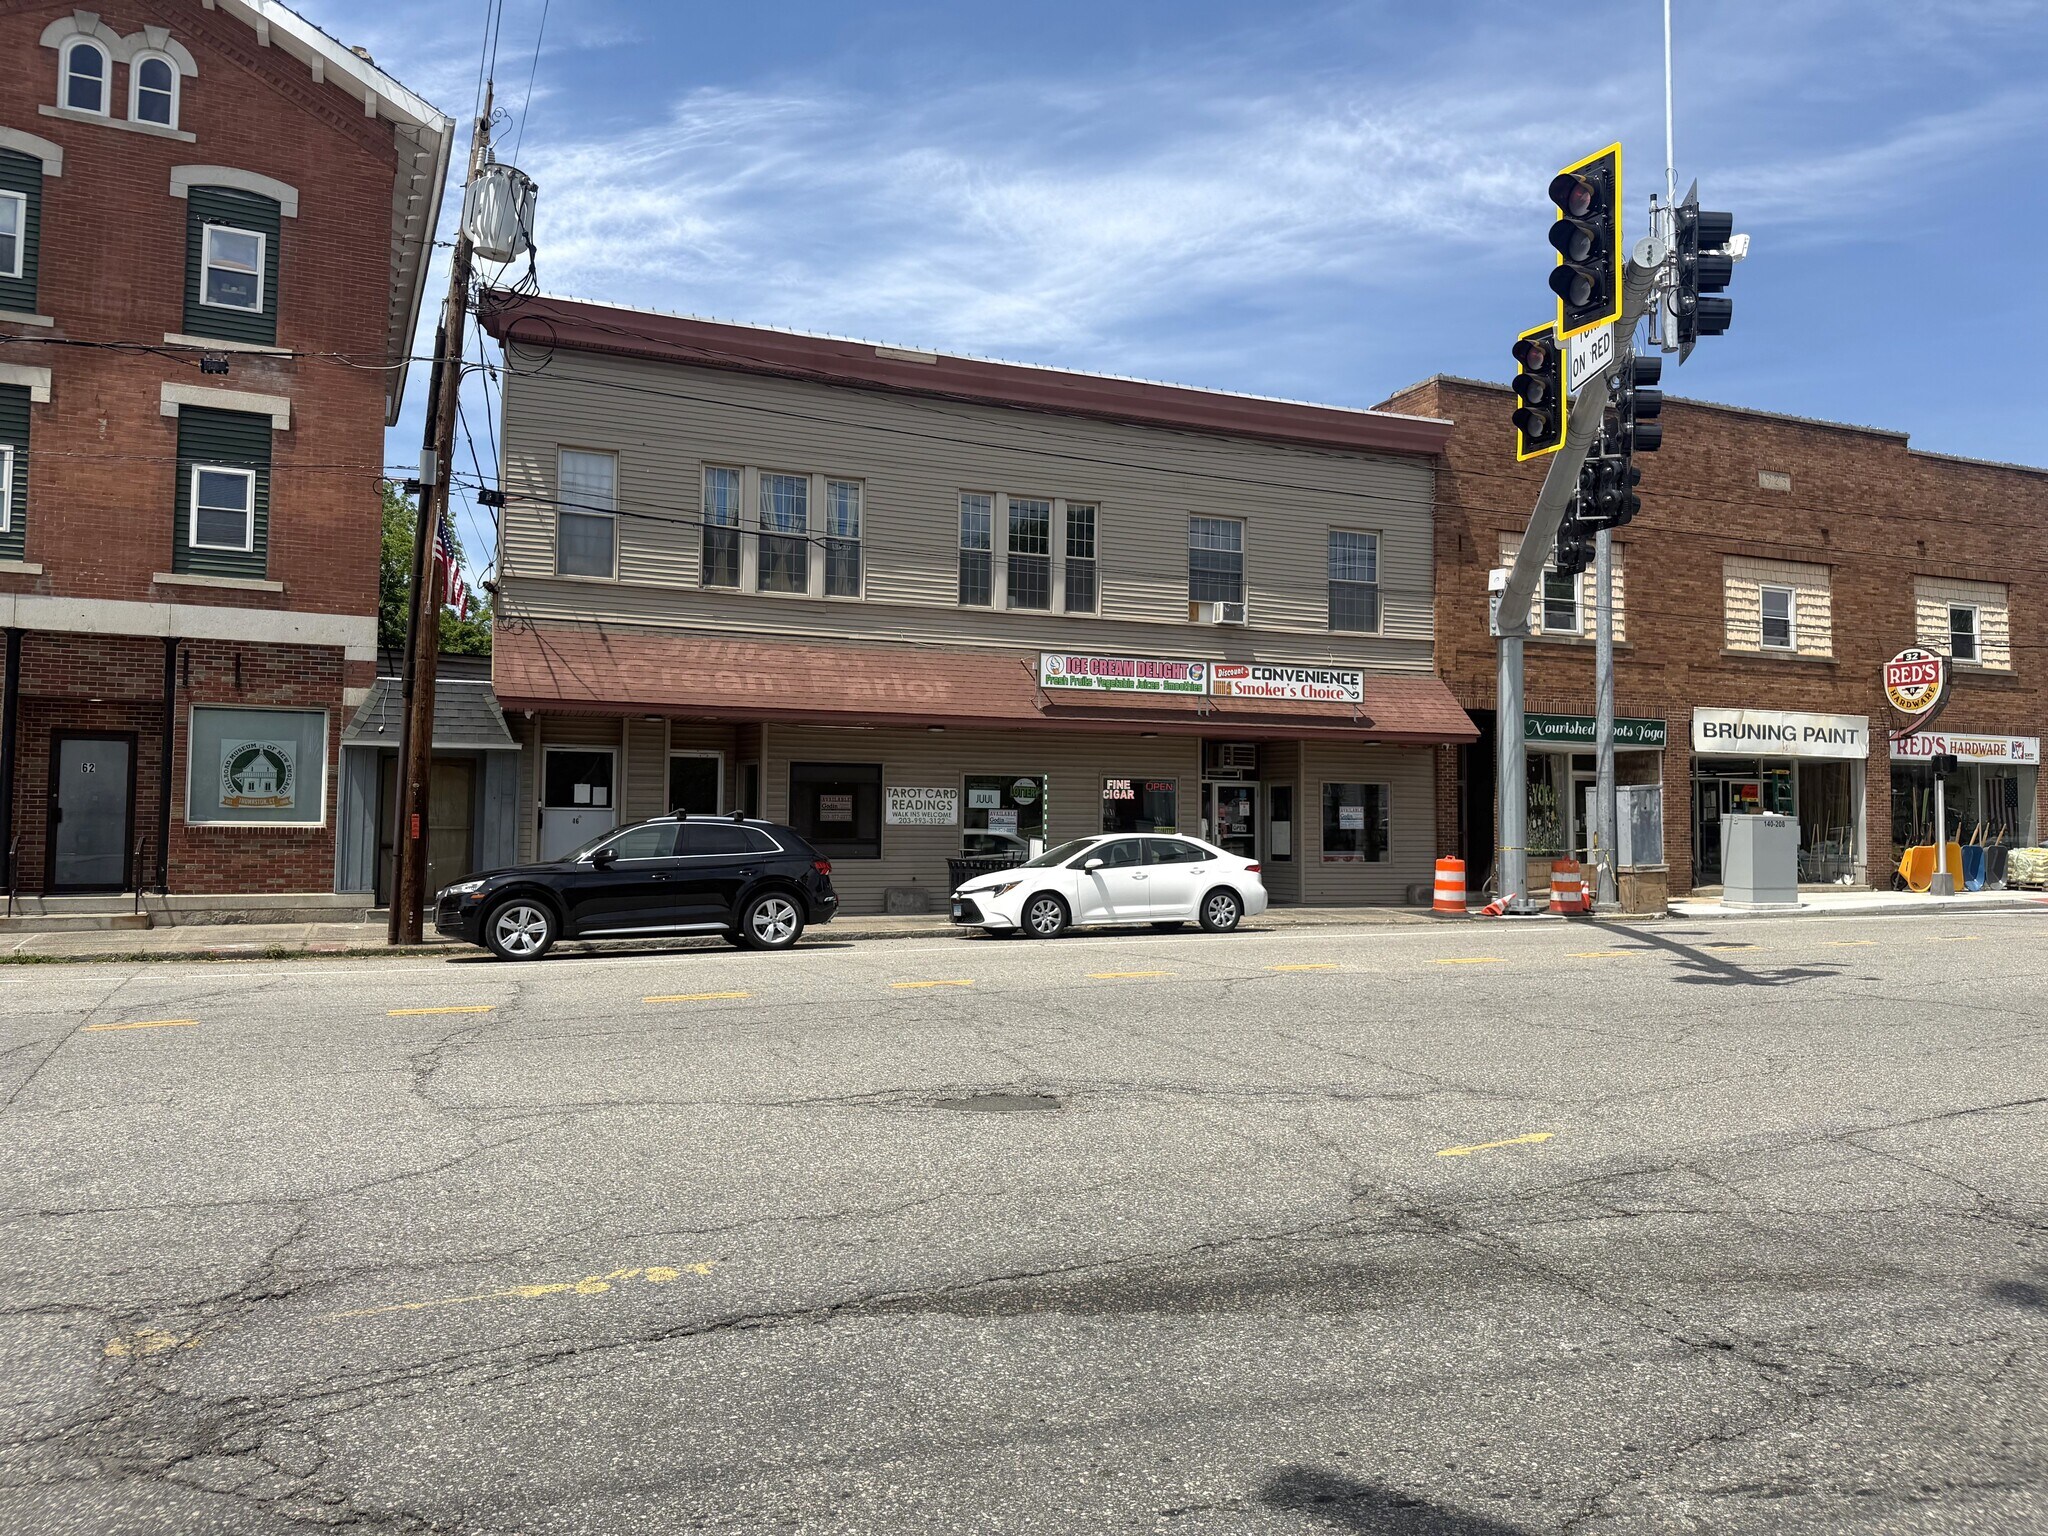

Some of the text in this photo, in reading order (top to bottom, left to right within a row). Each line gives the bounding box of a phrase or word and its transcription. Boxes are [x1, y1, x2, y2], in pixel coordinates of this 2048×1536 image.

[1573, 352, 1585, 378] ON
[1592, 333, 1610, 364] RED
[1905, 653, 1919, 661] 32
[1066, 657, 1189, 680] ICE CREAM DELIGHT
[1217, 667, 1244, 678] Discount
[1251, 667, 1359, 686] CONVENIENCE
[1889, 663, 1936, 684] RED'S
[617, 659, 791, 694] Cream
[810, 669, 950, 699] Parlor
[1045, 674, 1203, 692] Fresh Fruits Vegetable Juices Smoothies
[1234, 680, 1344, 700] Smoker's Choice
[1890, 686, 1936, 708] HARDWARE
[1524, 719, 1664, 741] Nourished oots Yoga
[1703, 722, 1859, 745] BRUNING PAINT
[229, 743, 257, 760] MUSEUM
[1896, 735, 2007, 757] RED'S HARDWARE
[277, 750, 290, 763] NEW
[82, 763, 95, 773] 62
[223, 760, 236, 794] RAILROAD
[278, 764, 293, 795] ENGLAND
[1106, 779, 1131, 790] FINE
[887, 788, 958, 799] TAROT CARD
[1010, 785, 1040, 799] LOTTERY
[1102, 789, 1135, 800] CIGAR
[1145, 782, 1174, 791] OPEN
[891, 799, 953, 811] READINGS
[975, 794, 994, 804] JUUL
[1763, 820, 1786, 828] 140-208
